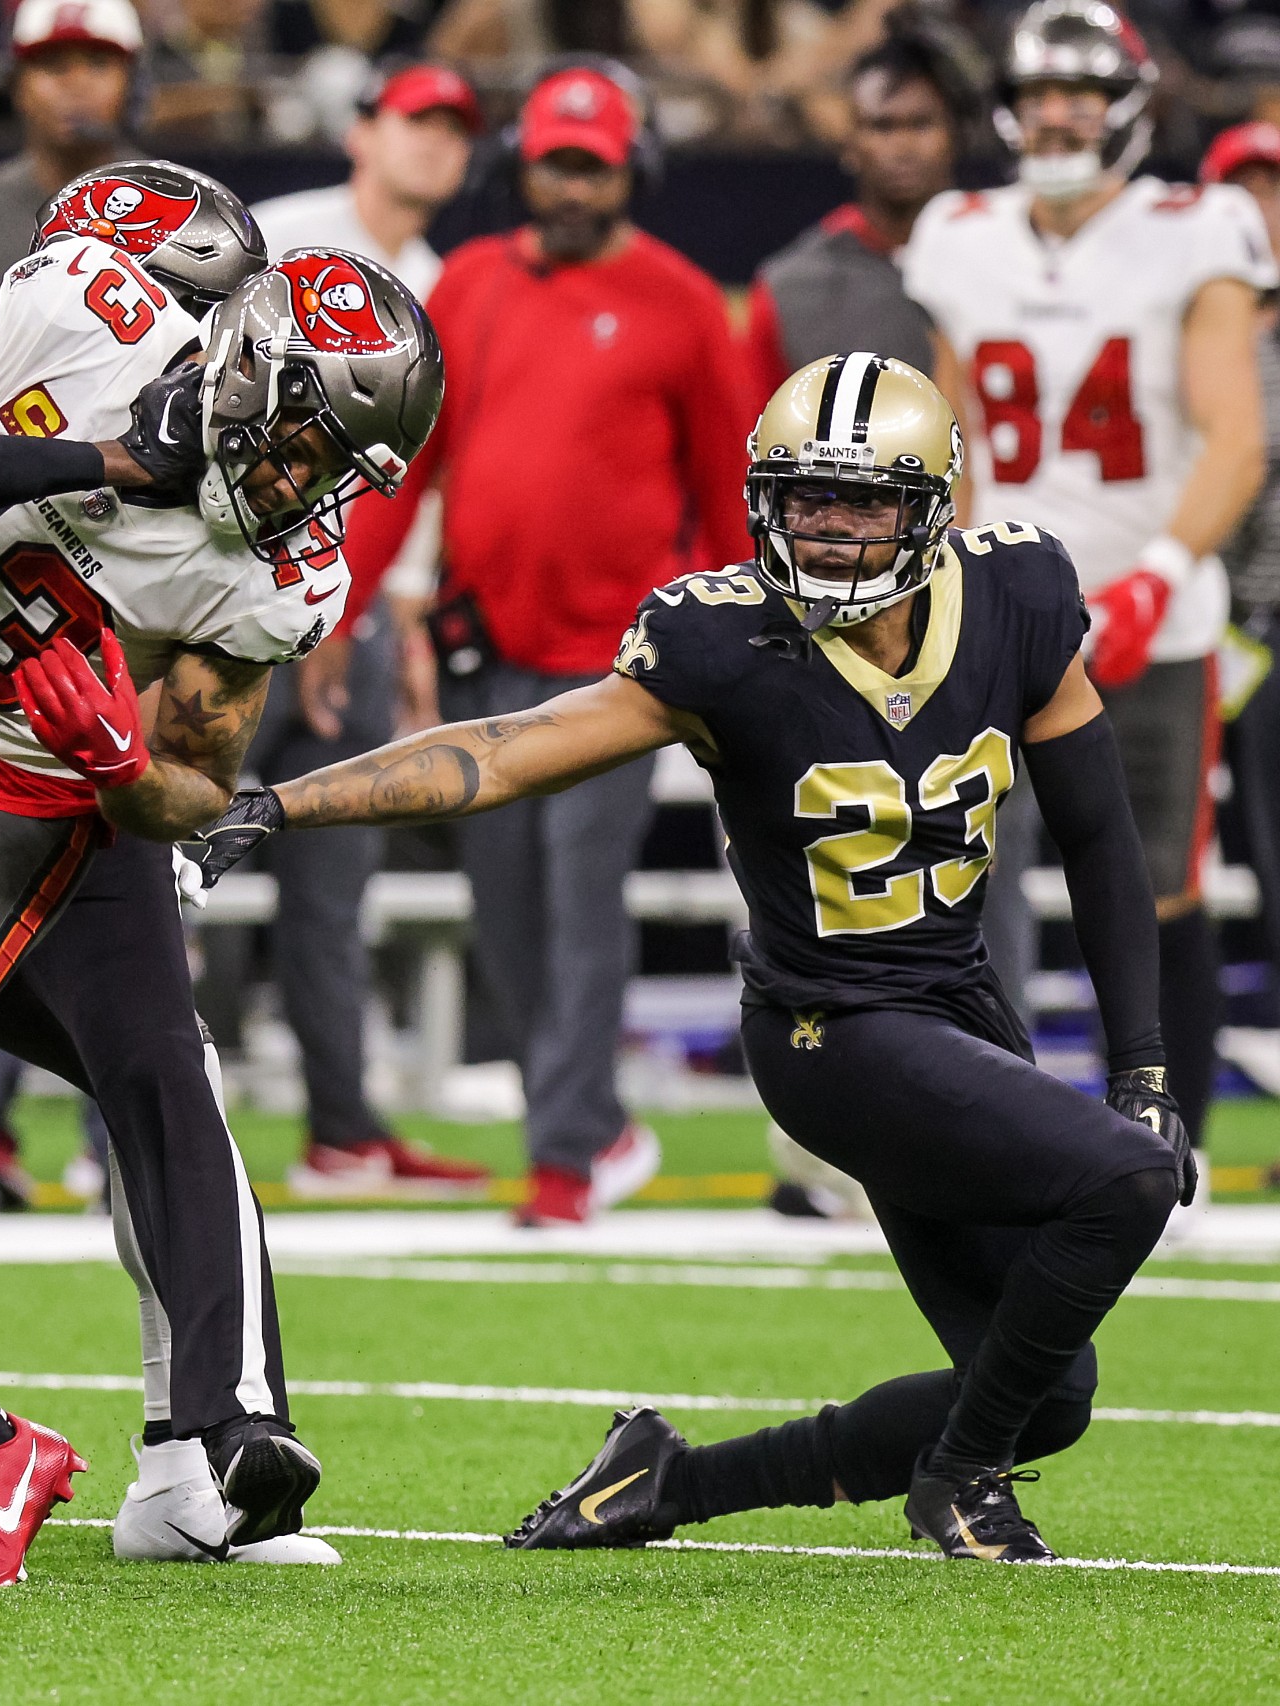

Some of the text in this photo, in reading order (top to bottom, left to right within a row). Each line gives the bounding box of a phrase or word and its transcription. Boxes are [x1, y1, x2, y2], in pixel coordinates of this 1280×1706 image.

[84, 249, 167, 345] 13
[12, 389, 61, 438] C
[976, 337, 1146, 484] 84
[819, 447, 858, 459] SAINTS
[961, 519, 1060, 556] 2
[891, 705, 910, 719] NFL
[794, 726, 1015, 938] 23
